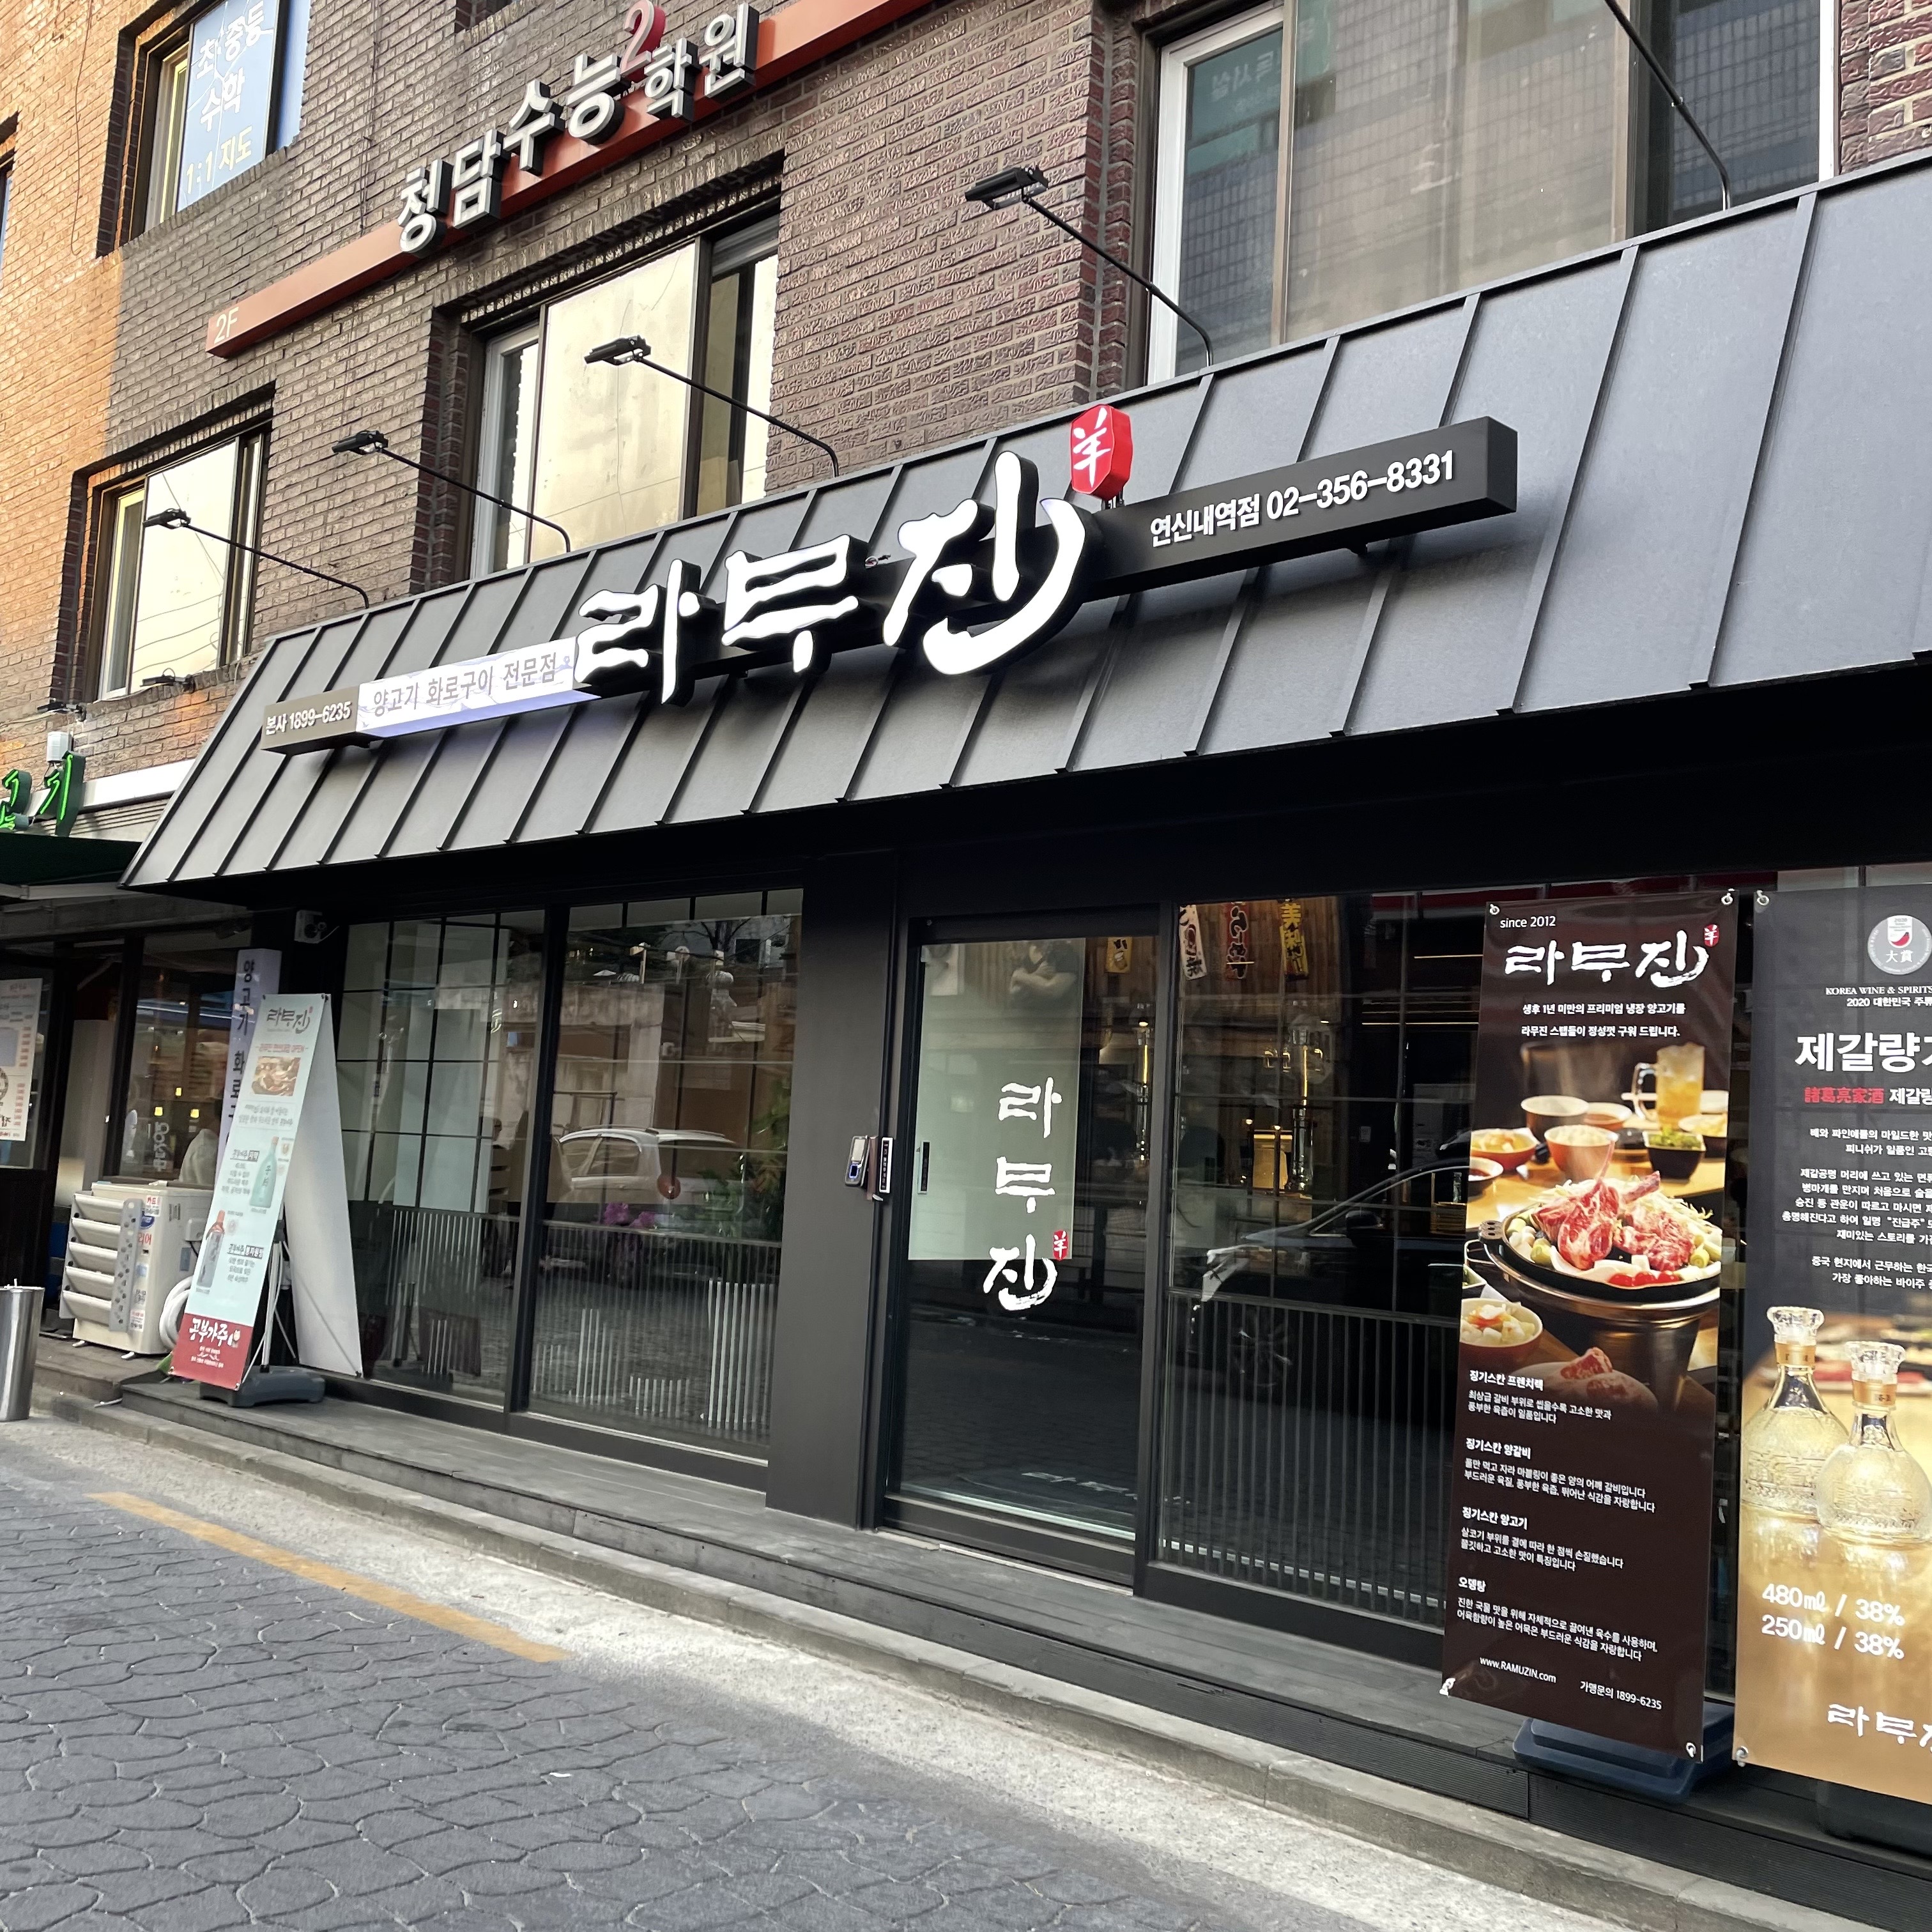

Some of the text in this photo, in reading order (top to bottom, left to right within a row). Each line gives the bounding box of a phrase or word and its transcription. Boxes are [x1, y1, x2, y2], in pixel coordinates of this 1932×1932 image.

[200, 66, 246, 133] 수학
[187, 125, 253, 194] 1:1 지도
[213, 306, 240, 344] 2F
[1150, 449, 1454, 548] 연신내역점 02-356-8331
[574, 450, 1086, 705] 라무진
[374, 652, 558, 717] 양고기 화로구이 전문점
[265, 701, 352, 736] 본사 1899-6235
[1499, 916, 1557, 929] since 2012
[1504, 930, 1710, 988] 라무진
[237, 959, 255, 1036] 양고기
[1825, 987, 1857, 995] KOREA
[1859, 986, 1885, 995] WINE
[1887, 986, 1896, 994] &
[1846, 997, 1871, 1008] 2020
[1873, 997, 1912, 1008] 대한민국
[266, 1006, 311, 1034] 라무진
[1522, 1002, 1686, 1015] 생후 1년 미만의 프리미엄 냉장 양고기를
[1521, 1025, 1548, 1037] 라무진
[1588, 1025, 1616, 1037] 정성껏
[1618, 1025, 1637, 1037] 구워
[1639, 1025, 1681, 1038] 드립니다.
[1794, 1032, 1932, 1073] 제갈량
[1809, 1128, 1829, 1138] 배와
[1832, 1128, 1878, 1140] 파인애플의
[1881, 1130, 1919, 1141] 마일드한
[1845, 1144, 1883, 1155] 피니쉬가
[1886, 1145, 1915, 1156] 일품인
[1800, 1168, 1837, 1180] 제갈공명
[1840, 1169, 1868, 1181] 머리에
[1871, 1171, 1891, 1181] 쓰고
[1894, 1172, 1914, 1183] 있는
[982, 1076, 1063, 1312] 라무진
[1802, 1183, 1839, 1195] 병마개를
[1842, 1184, 1870, 1196] 만지며
[1873, 1186, 1912, 1197] 처음으로
[1781, 1211, 1837, 1224] 총명해진다고
[1839, 1215, 1859, 1225] 하여
[1862, 1215, 1882, 1227] 일명
[1795, 1197, 1814, 1208] 승진
[1816, 1199, 1827, 1209] 등
[1830, 1199, 1858, 1211] 관운이
[1861, 1200, 1890, 1211] 따르고
[1892, 1202, 1922, 1213] 마시면
[1836, 1229, 1874, 1241] 재미있는
[1877, 1232, 1916, 1244] 스토리를
[1811, 1255, 1831, 1267] 중국
[1834, 1256, 1871, 1269] 현지에서
[1874, 1259, 1913, 1273] 근무하는
[1832, 1272, 1852, 1284] 가장
[1854, 1273, 1893, 1287] 좋아하는
[1896, 1277, 1926, 1289] 바이주
[189, 1317, 229, 1347] 공부가주
[1469, 1369, 1544, 1392] 징기스칸 프렌치랙
[1468, 1390, 1613, 1422] 최상급 갈비 부위로 씹을수록 고소한 맛과
[1468, 1401, 1558, 1425] 풍부한 육즙이 일품입니다
[1466, 1438, 1532, 1460] 징기스칸 양갈비
[1464, 1457, 1646, 1499] 풀만 먹고 자라 마블링이 좋은 양의 어깨 갈비입니다
[1464, 1469, 1496, 1485] 부드러운
[1516, 1478, 1540, 1492] 풍부한
[1561, 1486, 1586, 1501] 뛰어난
[1587, 1491, 1613, 1506] 식감을
[1613, 1496, 1656, 1514] 자랑합니다
[1462, 1506, 1528, 1531] 징기스칸 양고기
[1460, 1526, 1485, 1541] 살코기
[1486, 1531, 1510, 1546] 부위를
[1529, 1540, 1545, 1553] 따라
[1546, 1544, 1556, 1555] 한
[1557, 1545, 1574, 1559] 점씩
[1575, 1550, 1625, 1569] 손질했습니다
[1493, 1545, 1517, 1560] 고소한
[1518, 1550, 1535, 1564] 맛이
[1536, 1553, 1577, 1572] 특징입니다
[1457, 1576, 1487, 1593] 오뎅탕
[1457, 1597, 1474, 1609] 진한
[1475, 1600, 1492, 1614] 국물
[1492, 1604, 1509, 1618] 맛을
[1510, 1609, 1527, 1622] 위해
[1528, 1613, 1568, 1631] 자체적으로
[1569, 1621, 1595, 1637] 끓여낸
[1595, 1628, 1621, 1644] 육수를
[1855, 1598, 1906, 1627] 38%
[1497, 1617, 1514, 1631] 높은
[1540, 1628, 1572, 1646] 부드러운
[1574, 1636, 1598, 1652] 식감을
[1600, 1642, 1643, 1662] 자랑합니다
[1854, 1630, 1905, 1660] 38%
[1479, 1656, 1558, 1684] www.RAMUZIN.com
[1580, 1680, 1663, 1711] 가맹문의 1899-6235
